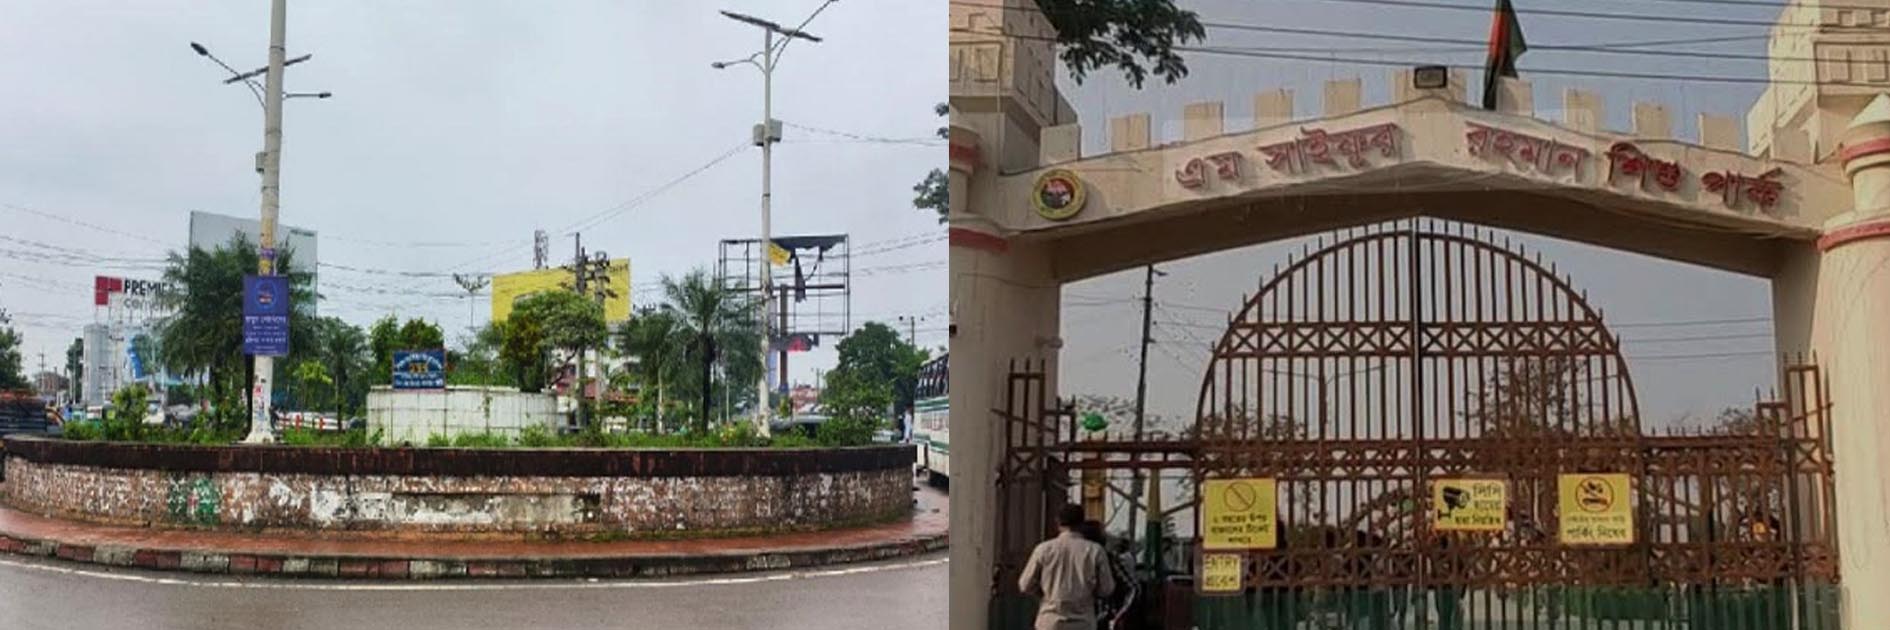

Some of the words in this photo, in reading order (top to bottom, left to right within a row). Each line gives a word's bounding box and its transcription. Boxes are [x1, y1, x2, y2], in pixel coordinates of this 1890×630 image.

[1175, 151, 1243, 189] এম
[1257, 122, 1400, 174] সাইফুর
[1465, 121, 1588, 183] রহমান
[1605, 142, 1682, 192] শিশু
[1701, 167, 1783, 209] পার্ক
